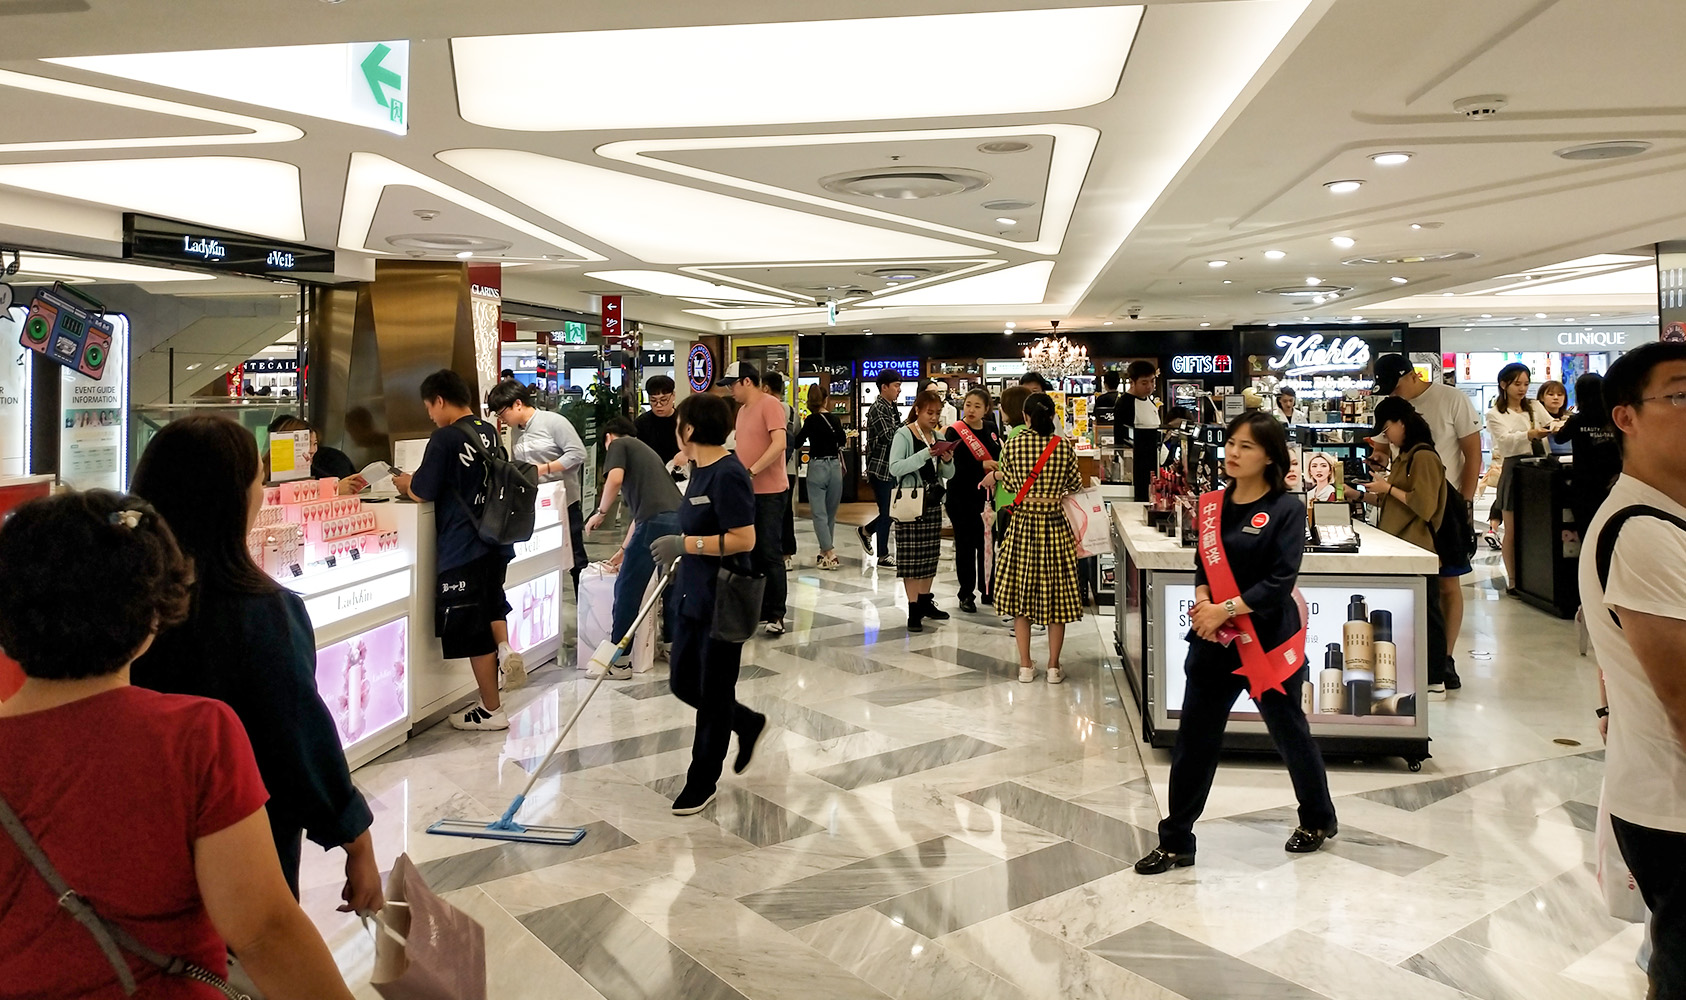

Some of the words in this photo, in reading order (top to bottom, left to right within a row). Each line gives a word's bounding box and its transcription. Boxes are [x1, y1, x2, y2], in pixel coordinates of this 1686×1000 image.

[471, 283, 500, 299] CLARINS
[1557, 332, 1628, 347] CLINIQUE
[1268, 333, 1370, 370] Kiehl's
[862, 360, 920, 369] CUSTOMER
[1171, 355, 1213, 374] GIFTS
[75, 386, 96, 394] EVENT
[97, 386, 116, 394] GUIDE
[72, 395, 117, 403] INFORMATION
